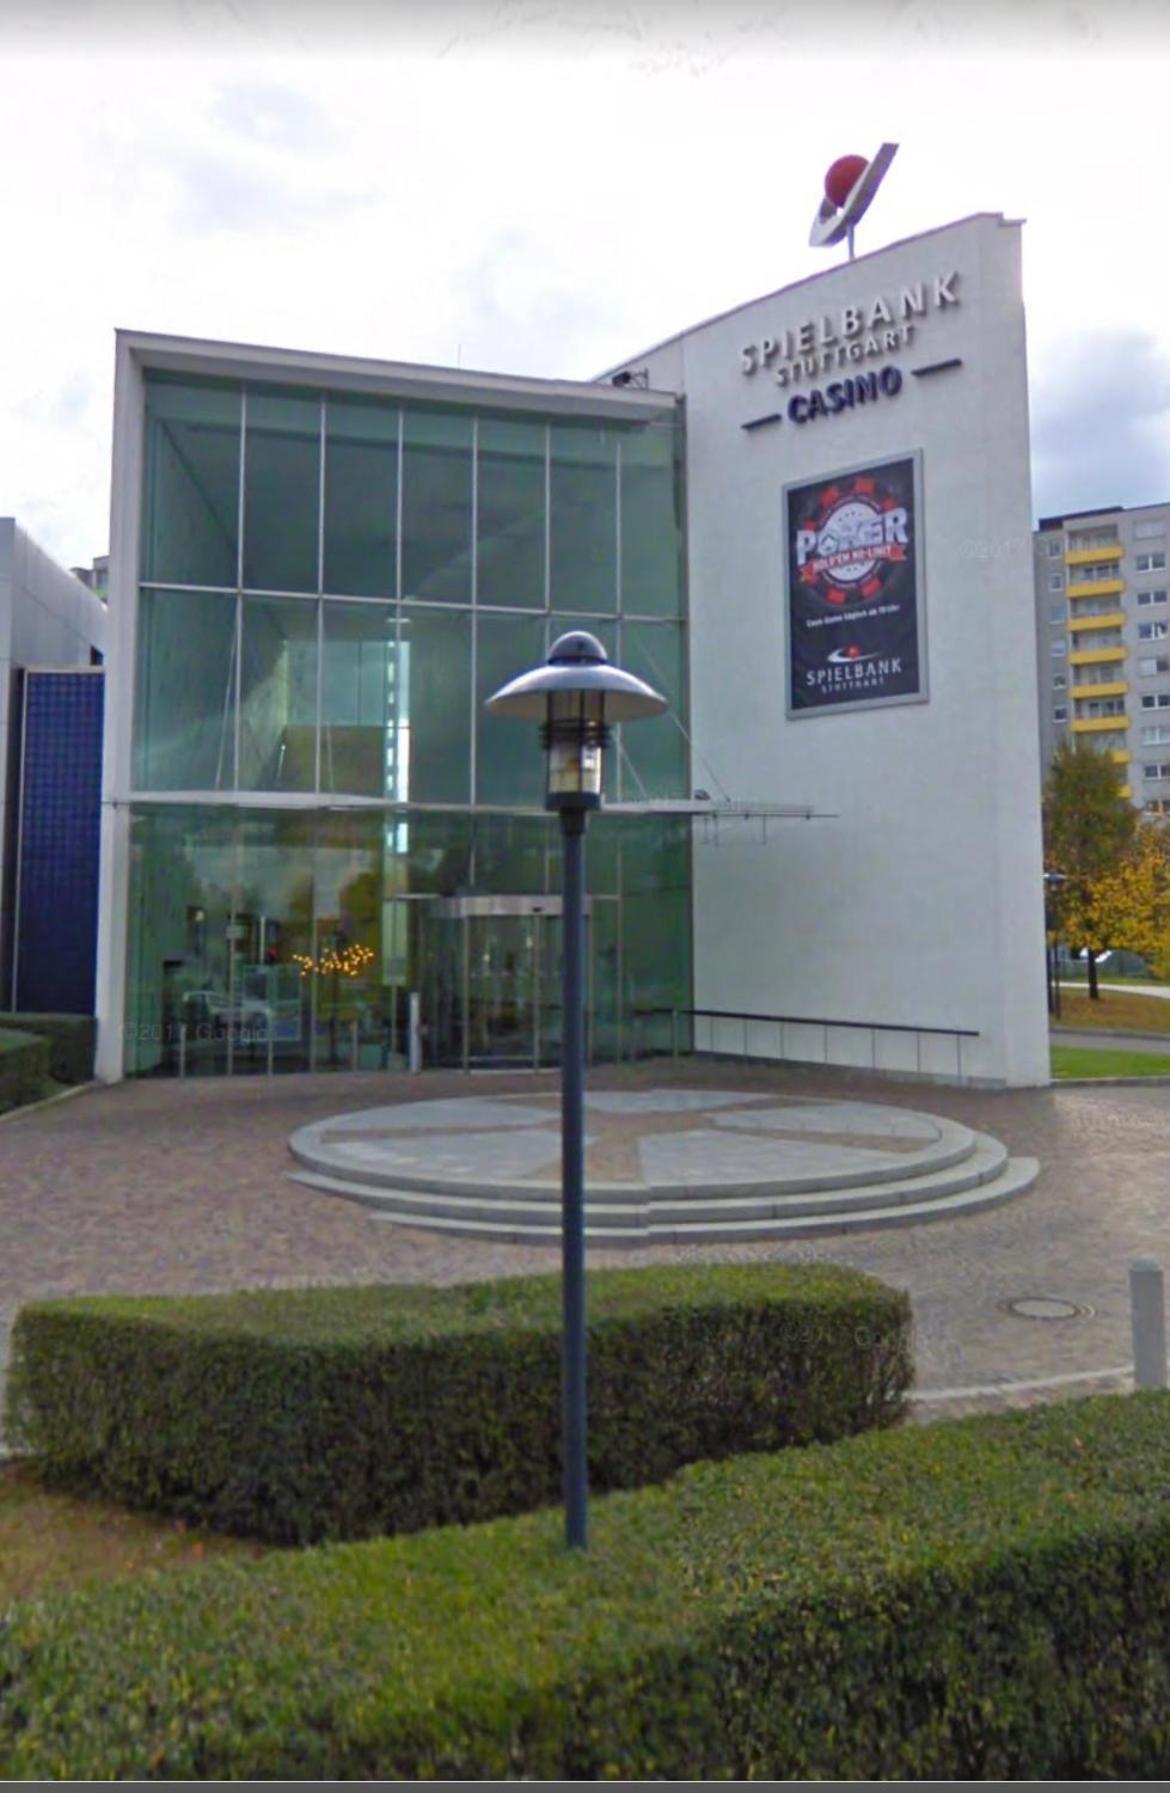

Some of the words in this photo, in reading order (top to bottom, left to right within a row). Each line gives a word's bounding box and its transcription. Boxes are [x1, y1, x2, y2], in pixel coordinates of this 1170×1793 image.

[741, 270, 959, 376] SPIELBANK
[777, 325, 915, 387] STUTTGART
[788, 365, 903, 424] CASINO
[796, 506, 909, 566] POKER
[805, 657, 902, 686] SPIELBANK
